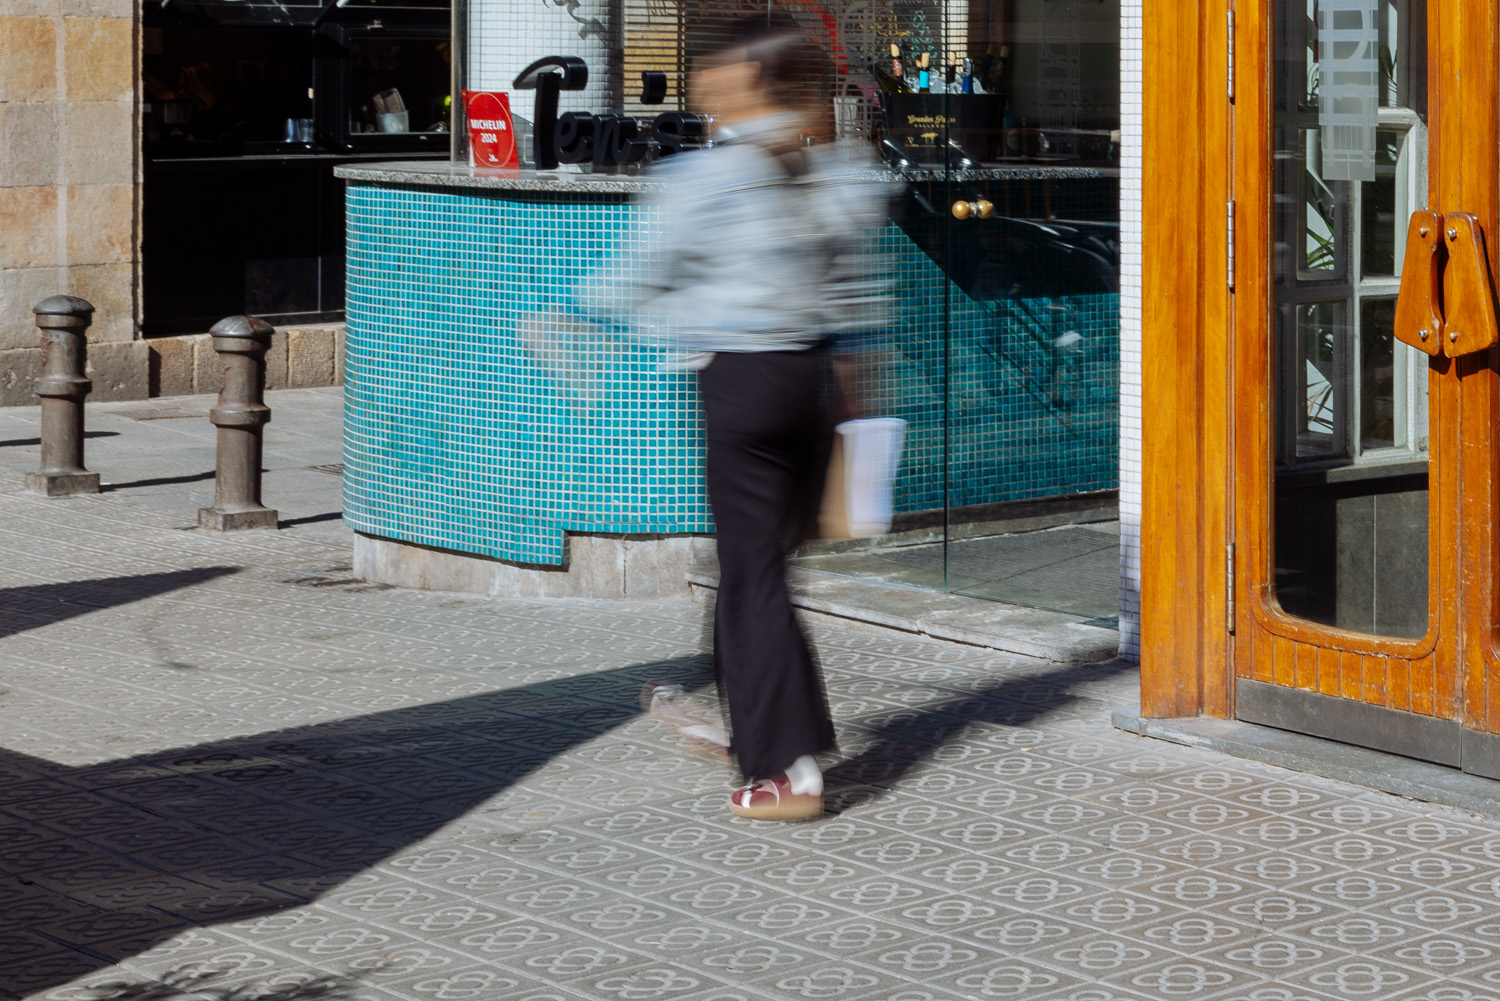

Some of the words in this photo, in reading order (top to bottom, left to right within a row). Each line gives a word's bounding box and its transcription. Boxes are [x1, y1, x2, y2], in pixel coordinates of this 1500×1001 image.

[513, 55, 702, 170] Ten's
[470, 119, 507, 131] MICHELIN
[480, 132, 498, 144] 2024
